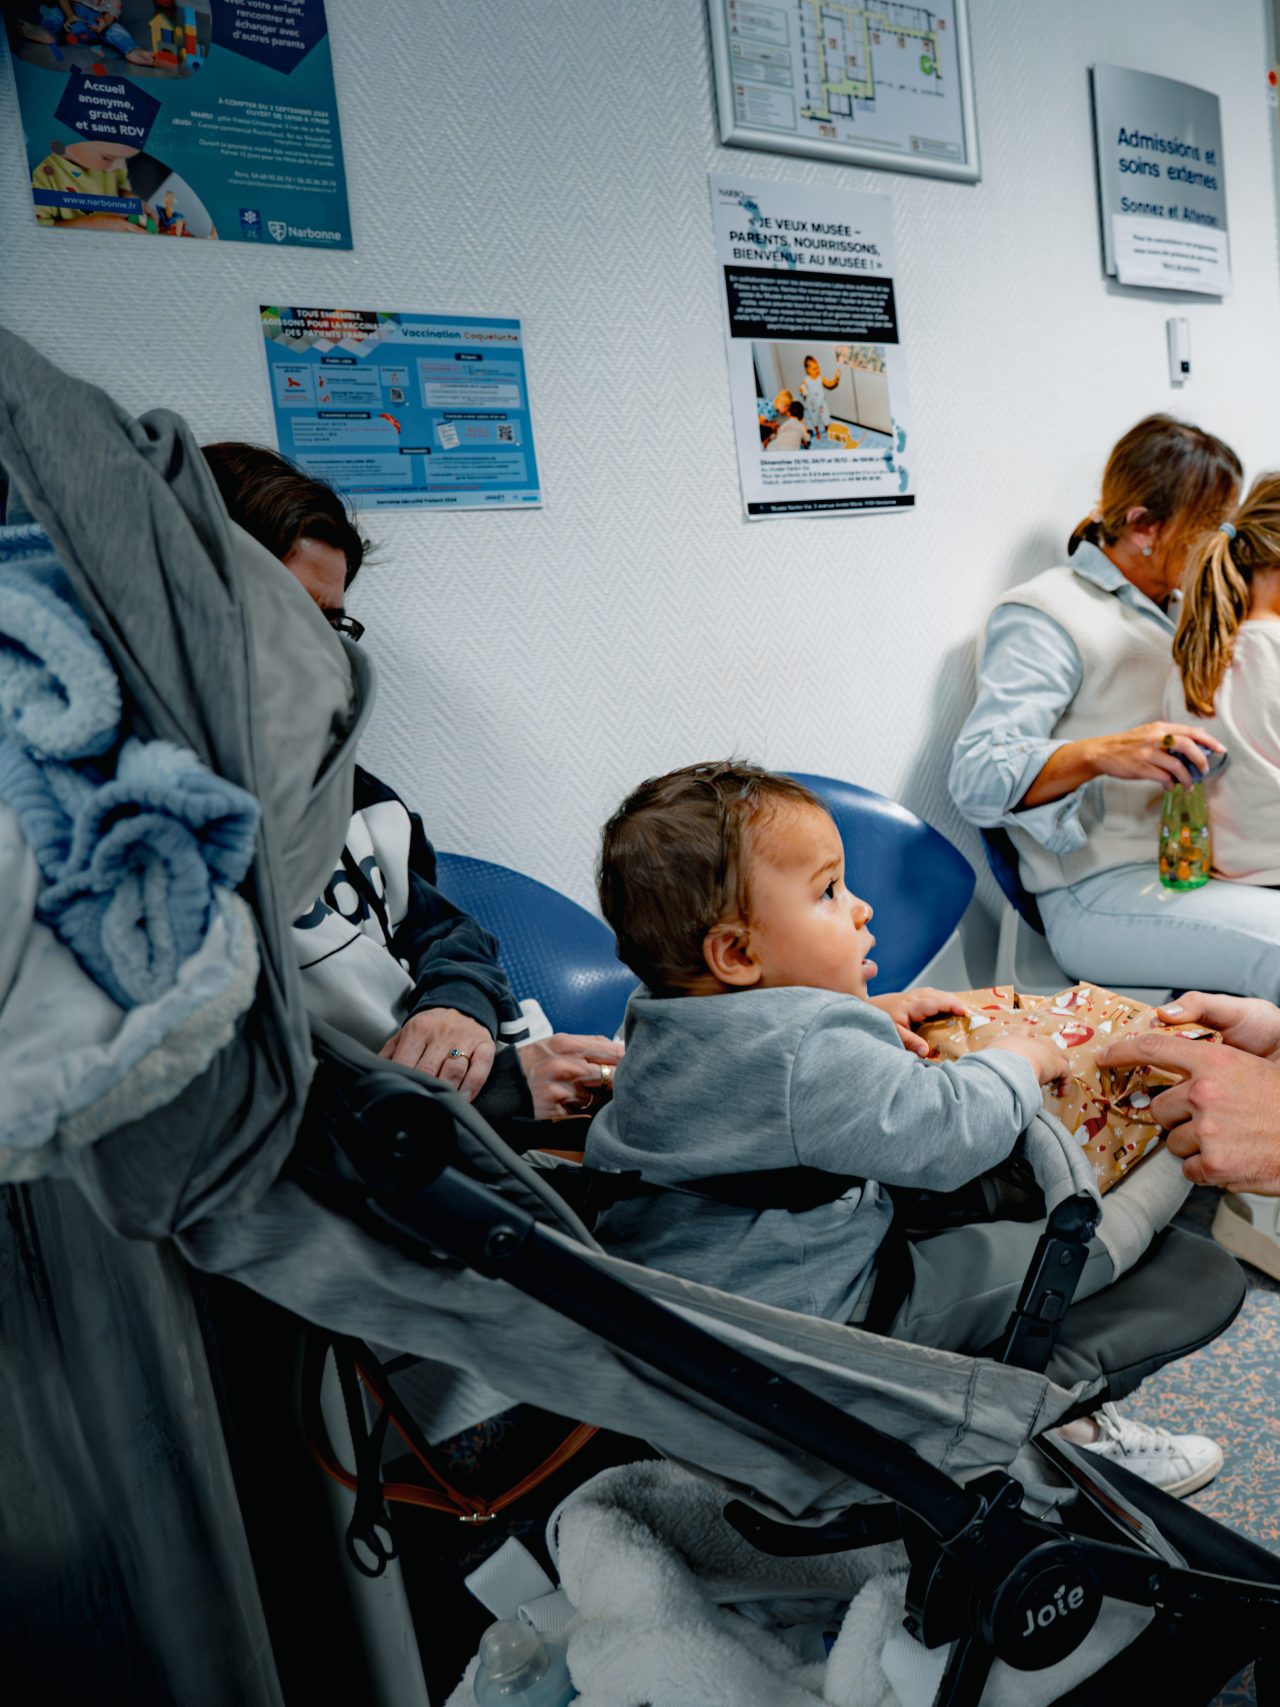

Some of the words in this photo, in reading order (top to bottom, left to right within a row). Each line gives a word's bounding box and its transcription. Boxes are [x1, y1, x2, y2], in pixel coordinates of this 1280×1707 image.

[247, 0, 272, 10] votre
[272, 3, 305, 17] enfant,
[236, 9, 283, 23] rencontrer
[285, 17, 295, 26] et
[234, 19, 278, 35] échanger
[279, 28, 301, 38] avec
[232, 30, 271, 44] d'autres
[271, 38, 306, 49] parents
[84, 79, 126, 95] Accueil
[78, 94, 135, 111] anonyme,
[88, 110, 130, 122] gratuit
[75, 121, 89, 131] et
[91, 123, 117, 134] sans
[119, 125, 145, 137] RDV
[1118, 127, 1201, 162] Admissions
[1204, 148, 1217, 166] et
[1119, 157, 1161, 178] soins
[1167, 166, 1218, 191] externes
[62, 196, 137, 209] www.narbonne.fr
[1120, 196, 1164, 217] Sonnez
[1168, 205, 1178, 219] et
[288, 226, 342, 241] Narbonne
[774, 218, 808, 232] VEUX
[811, 221, 852, 238] MUSÉE
[728, 231, 791, 247] PARENTS,
[793, 236, 881, 256] NOURRISSONS,
[732, 248, 807, 264] BIENVENUE
[809, 253, 826, 266] AU
[828, 255, 868, 270] MUSÉE
[297, 309, 320, 319] TOUS
[284, 328, 303, 338] DES
[306, 319, 329, 329] POUR
[331, 321, 342, 330] LA
[401, 328, 461, 339] Vaccination
[463, 331, 518, 342] Coqueluche
[1021, 1584, 1085, 1638] Joie
